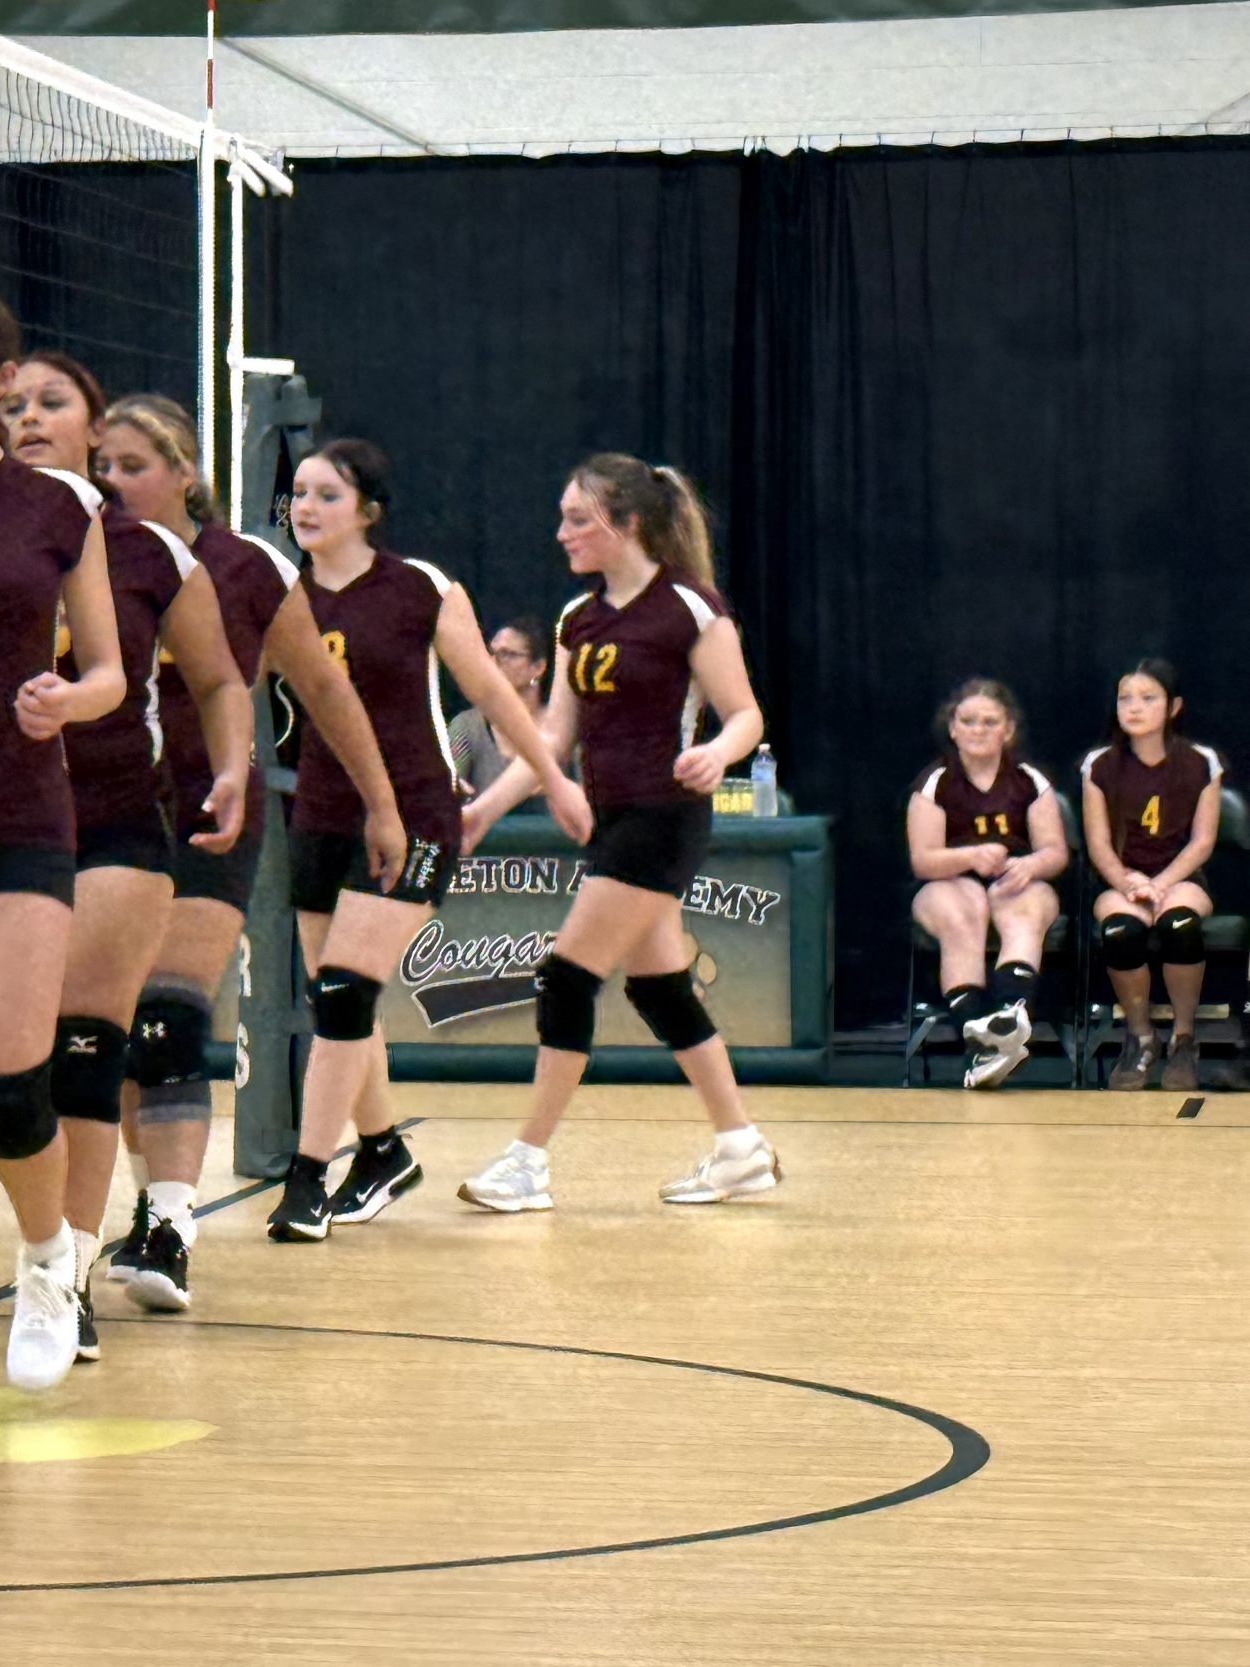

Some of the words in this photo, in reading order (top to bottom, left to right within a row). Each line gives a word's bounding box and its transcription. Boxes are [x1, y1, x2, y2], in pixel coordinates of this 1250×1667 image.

[575, 643, 617, 692] 12
[974, 813, 1010, 835] 11
[1141, 795, 1160, 835] 4
